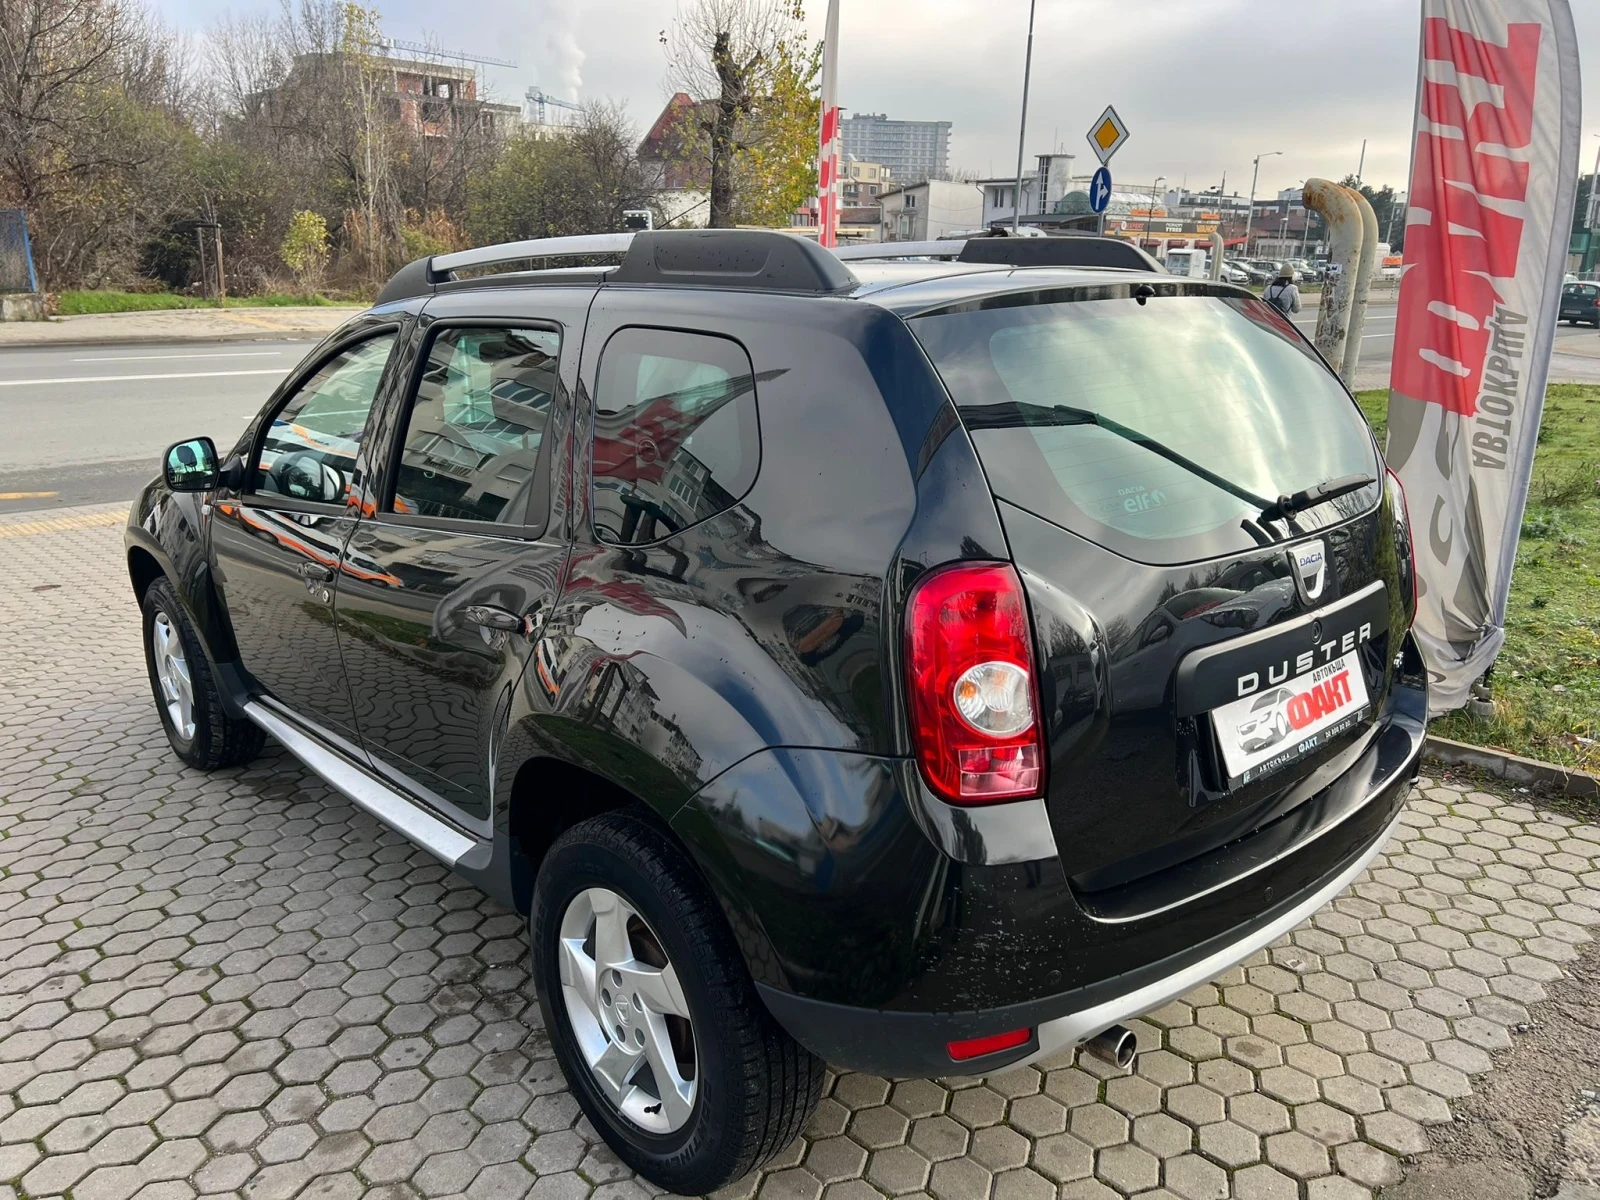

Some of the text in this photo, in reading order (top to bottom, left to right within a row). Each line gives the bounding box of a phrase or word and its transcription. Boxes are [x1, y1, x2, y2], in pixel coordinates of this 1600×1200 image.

[1118, 485, 1146, 496] DACIA
[1299, 552, 1323, 567] DACIA
[1237, 622, 1372, 697] DUSTER
[1312, 658, 1346, 684] АВТОКЪЩА
[1286, 669, 1352, 731] ФАКТ
[1298, 736, 1318, 753] ФАКТ
